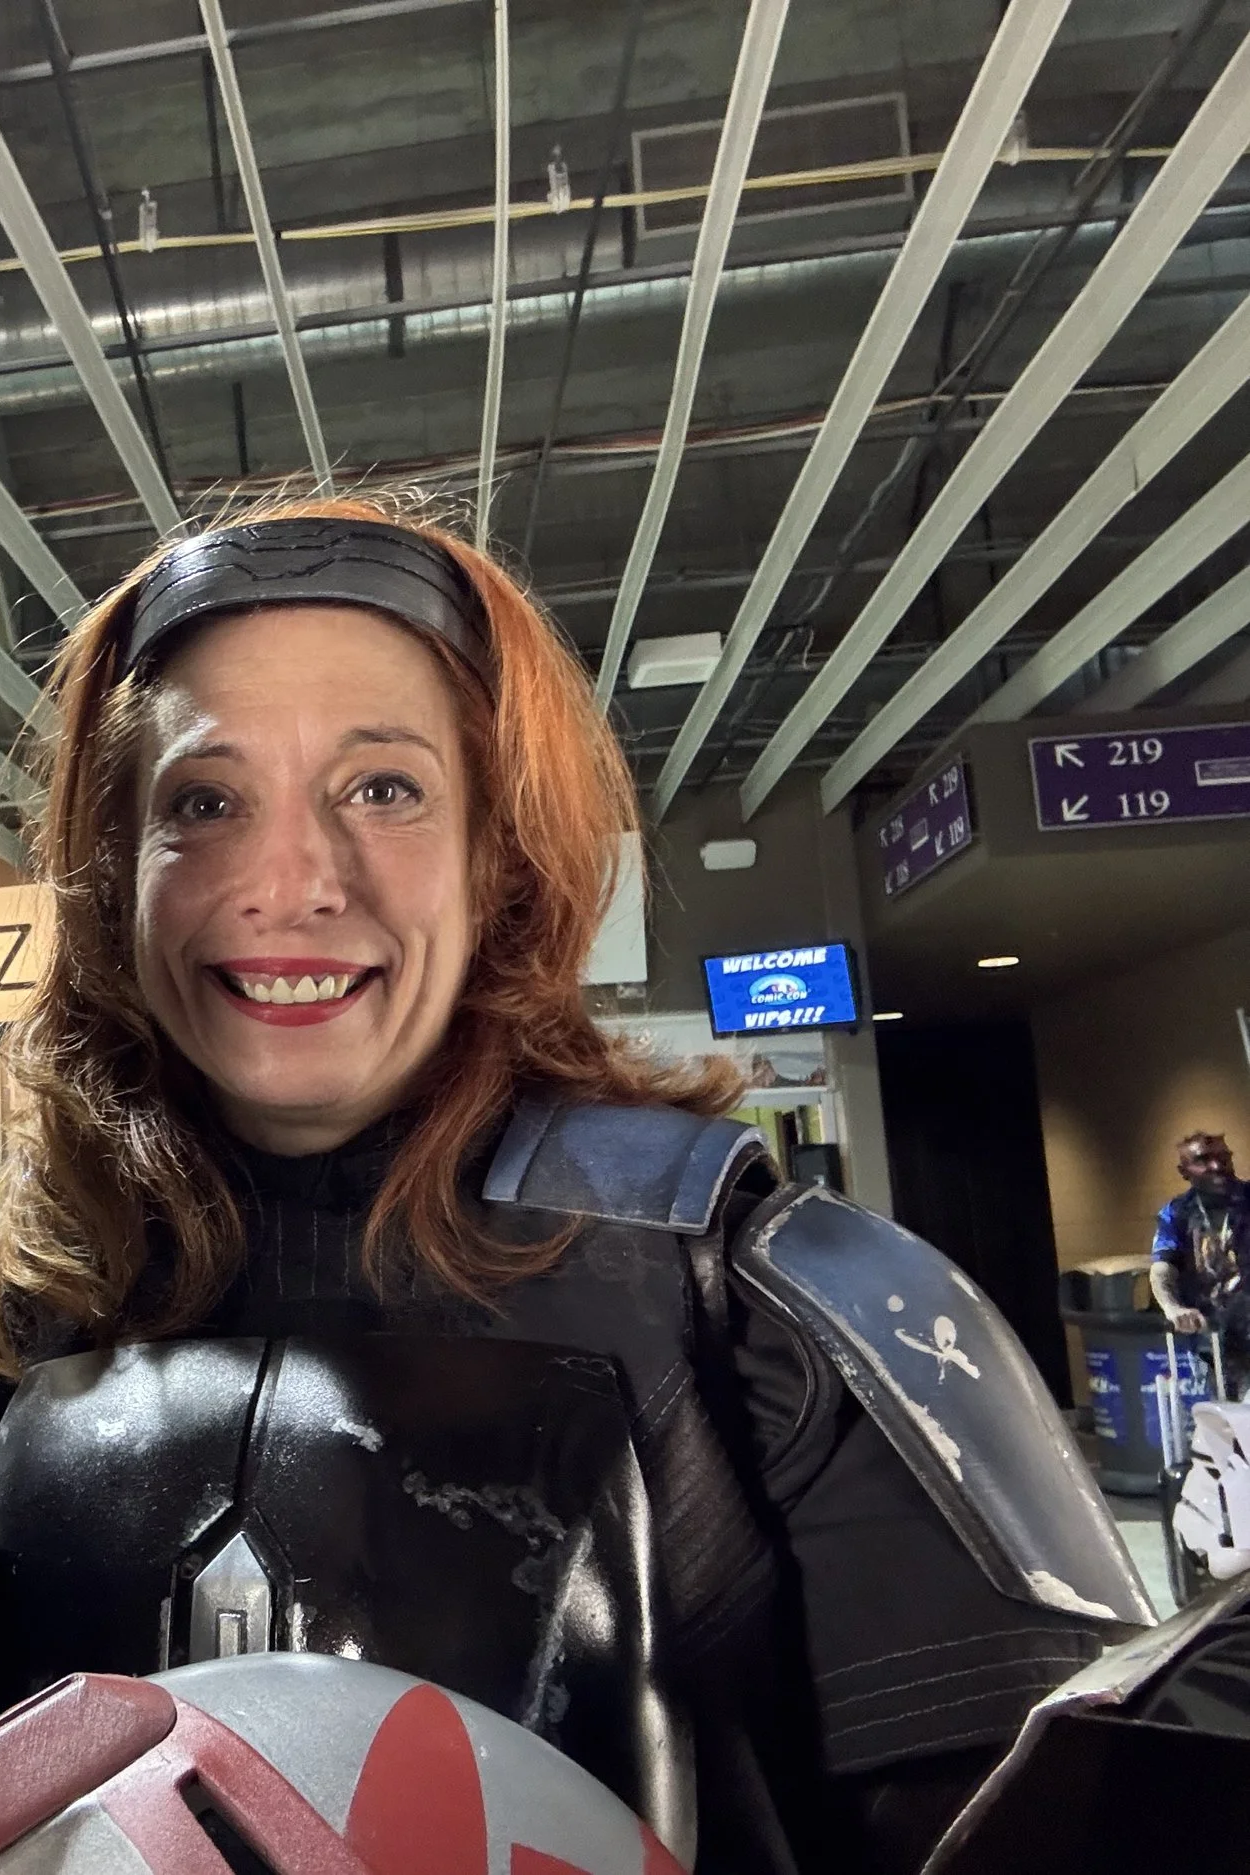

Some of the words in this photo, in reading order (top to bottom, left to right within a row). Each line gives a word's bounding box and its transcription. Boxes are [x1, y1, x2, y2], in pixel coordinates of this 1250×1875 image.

[1108, 738, 1163, 766] 219
[1118, 790, 1170, 818] 119
[723, 947, 828, 975] WELCOME
[751, 992, 784, 1004] COMIC
[786, 990, 808, 1000] CON
